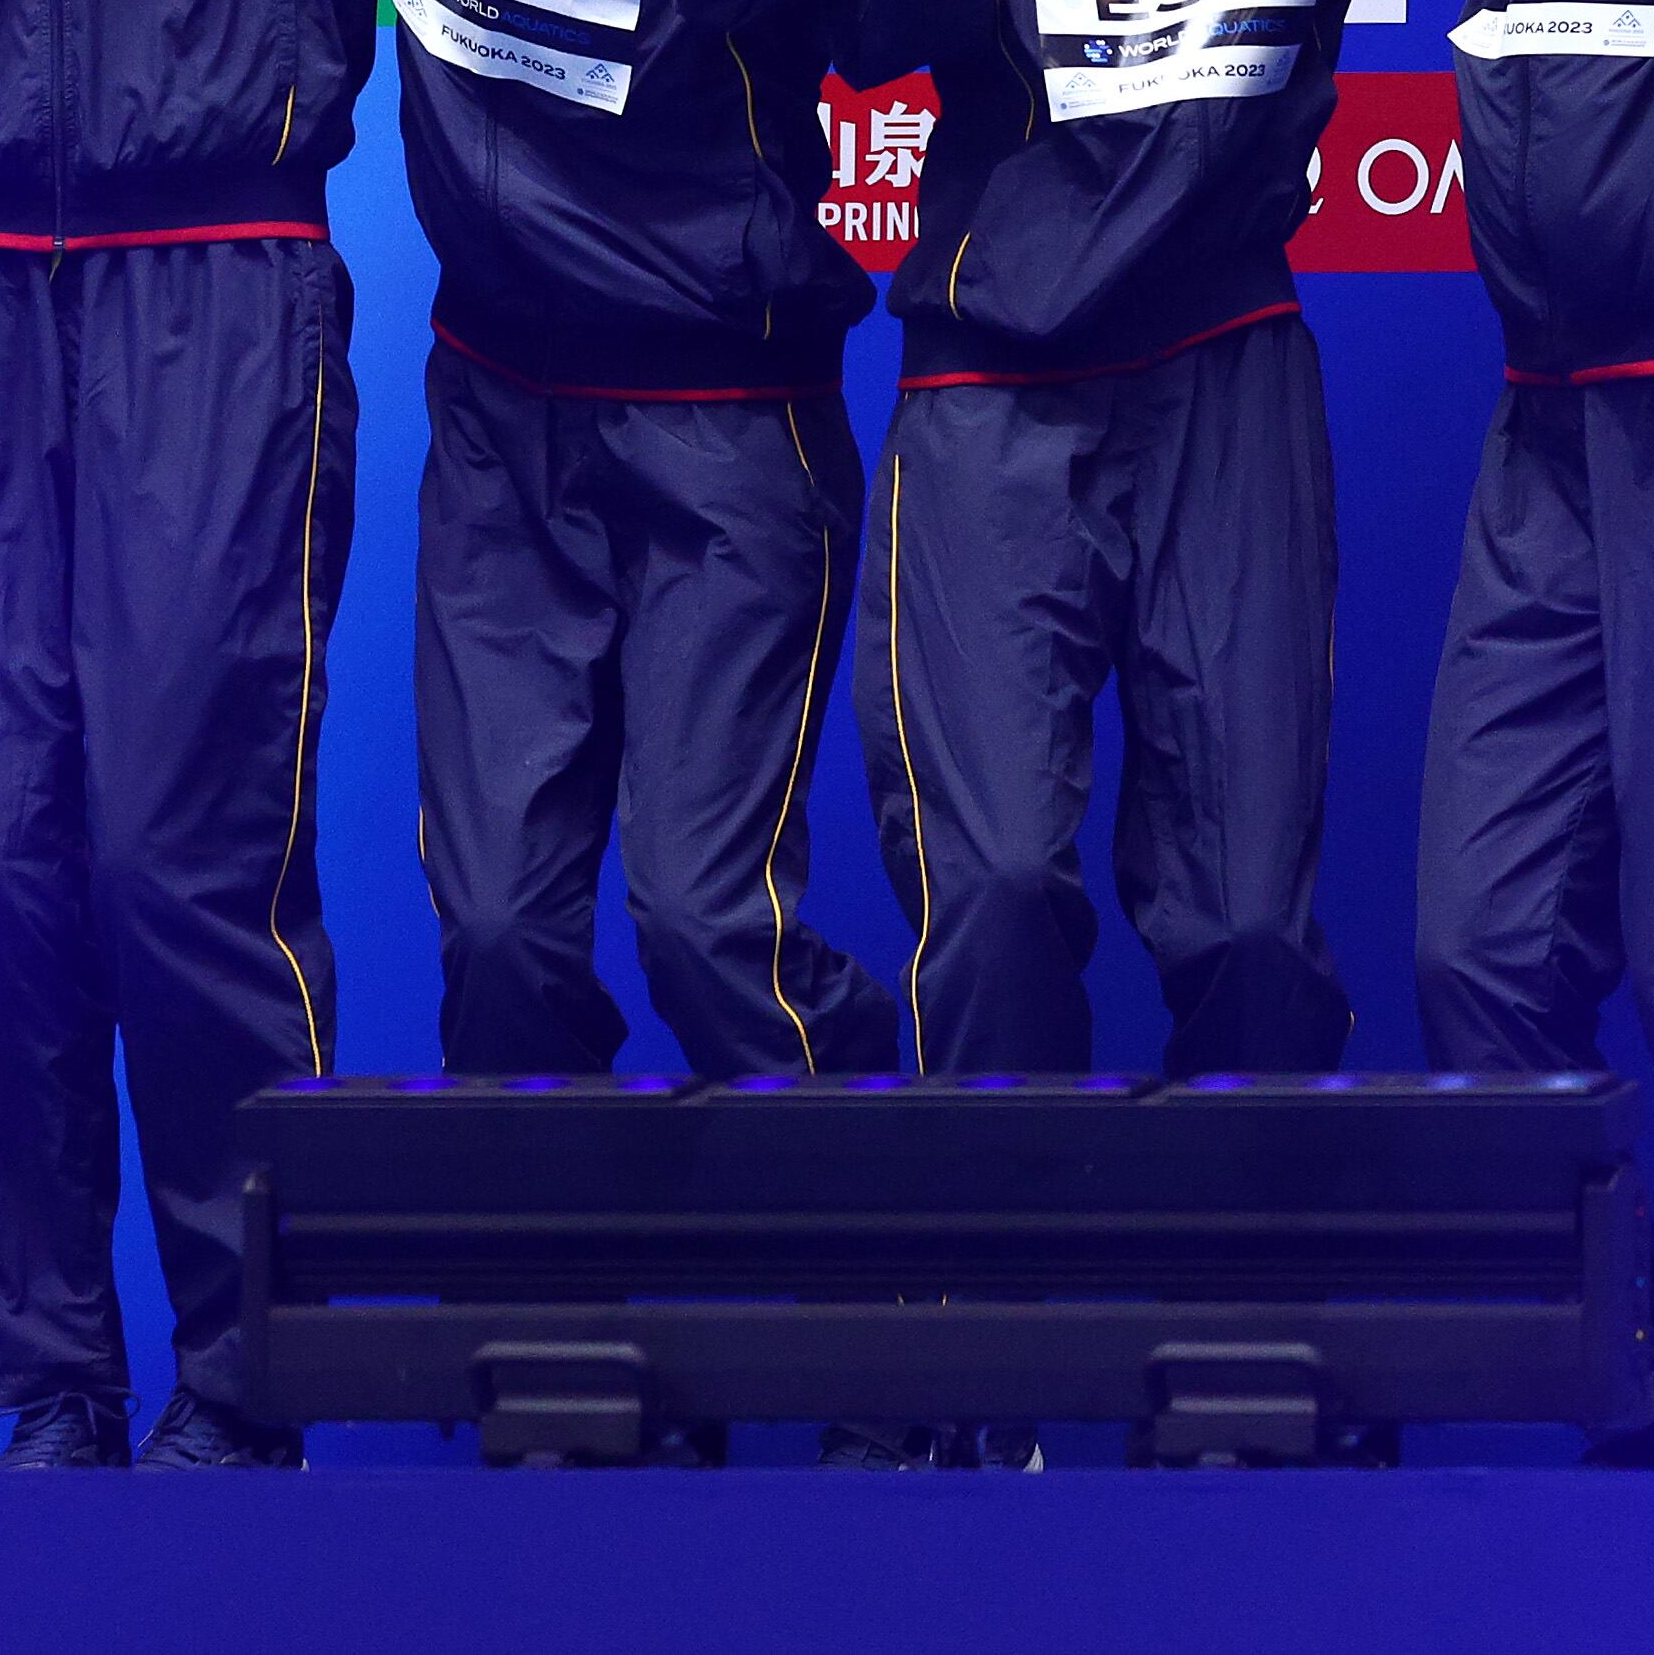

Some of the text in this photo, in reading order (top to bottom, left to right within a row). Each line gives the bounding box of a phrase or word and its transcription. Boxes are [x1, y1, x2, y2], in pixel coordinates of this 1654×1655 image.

[501, 10, 591, 45] AQUATICS
[1547, 21, 1593, 34] 2023
[441, 24, 566, 80] FUKUOKA 2023
[1118, 31, 1186, 58] WORL
[1224, 64, 1267, 78] 2023
